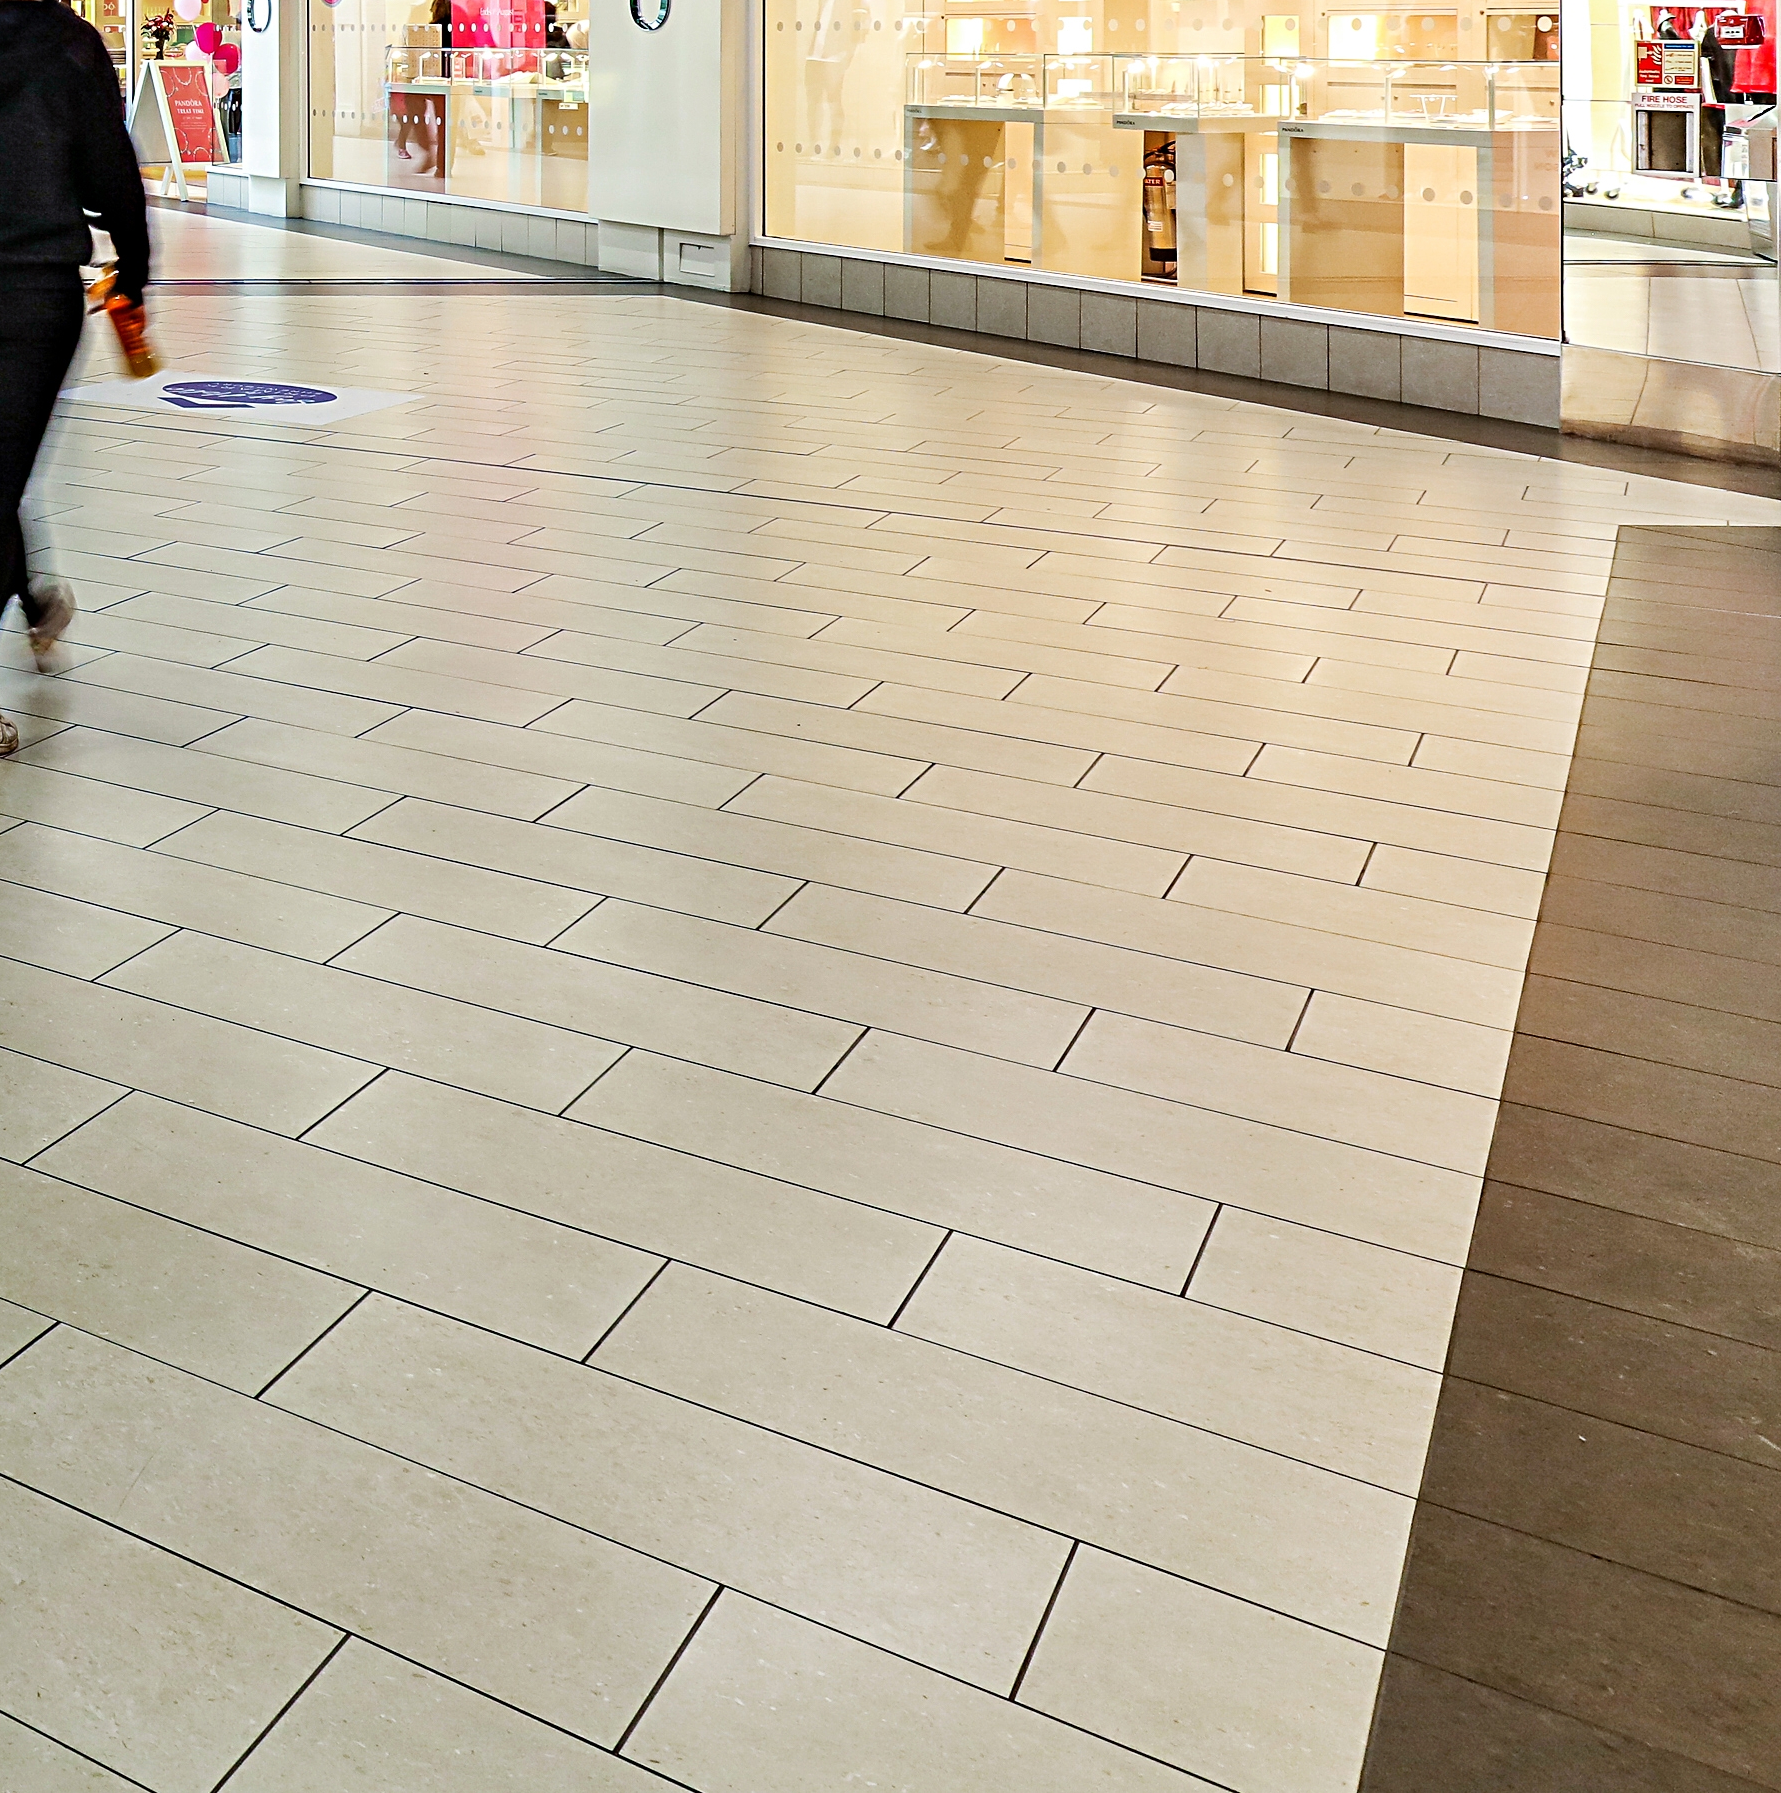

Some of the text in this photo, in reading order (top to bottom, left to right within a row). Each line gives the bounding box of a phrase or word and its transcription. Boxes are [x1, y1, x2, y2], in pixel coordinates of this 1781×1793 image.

[174, 99, 203, 107] PANDORA
[1641, 95, 1688, 104] FIRE HOSE
